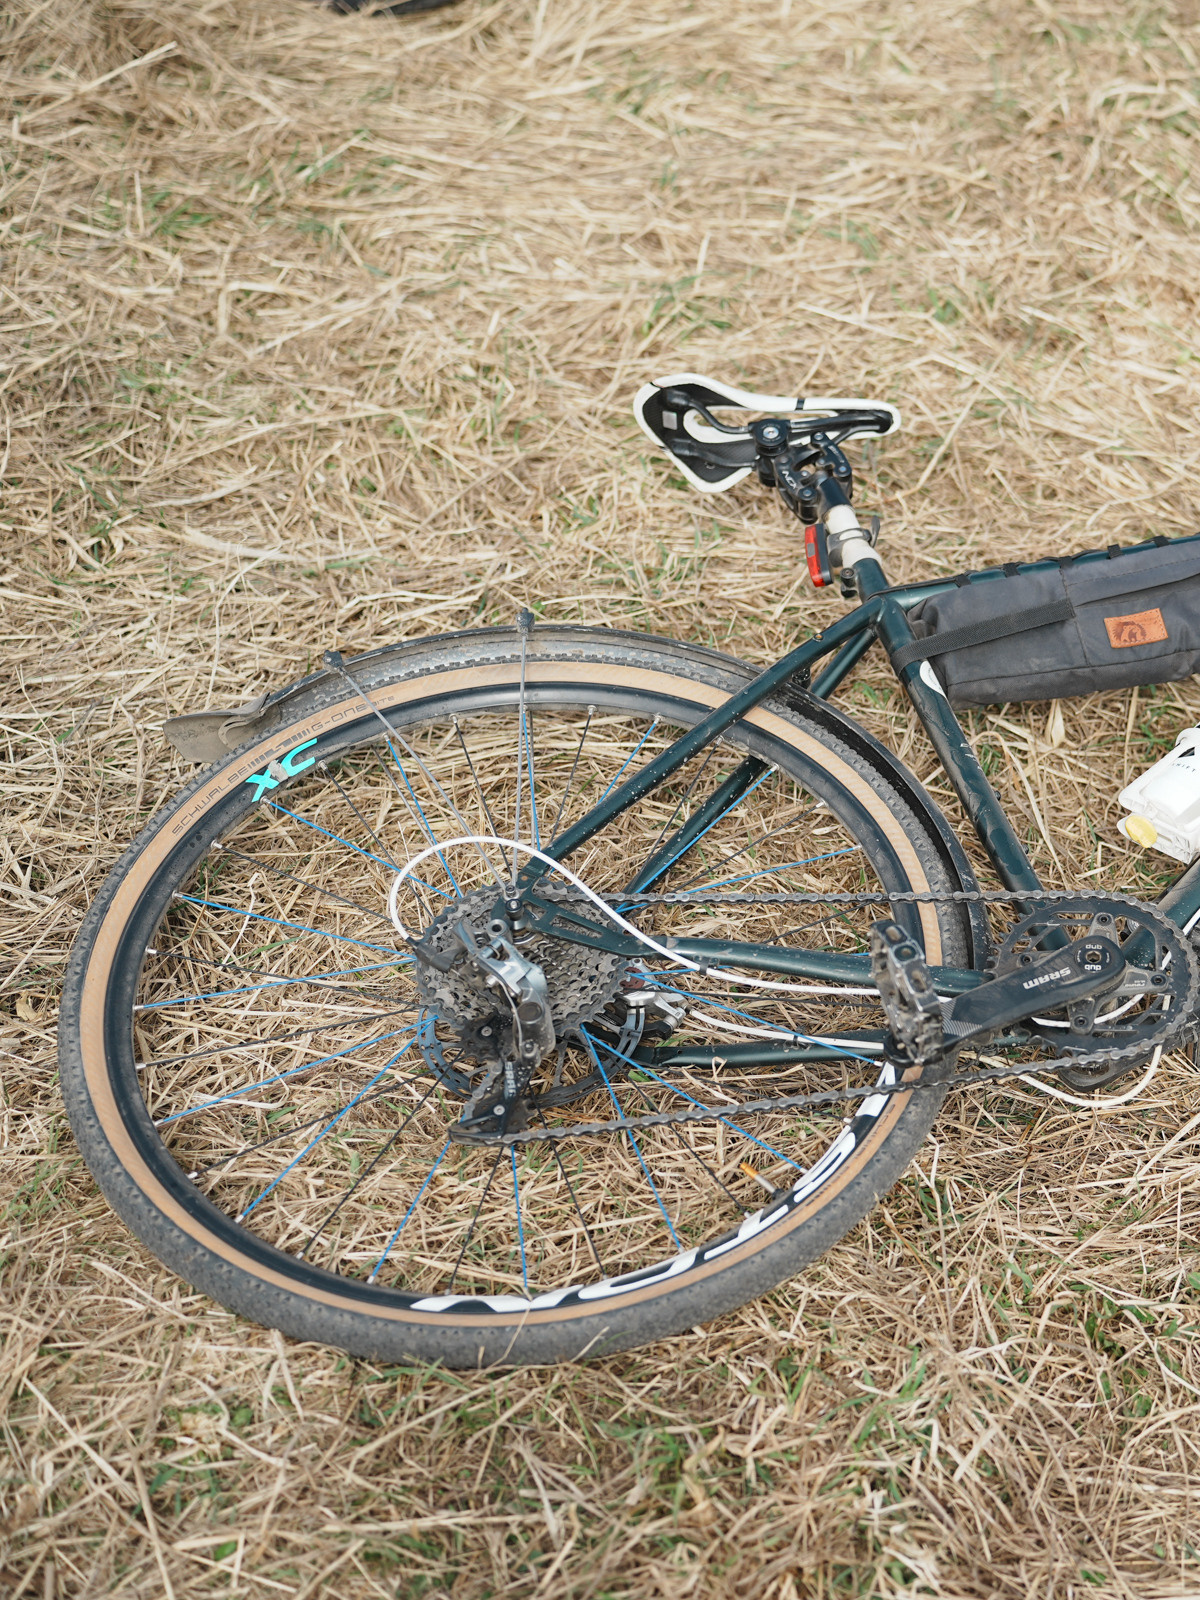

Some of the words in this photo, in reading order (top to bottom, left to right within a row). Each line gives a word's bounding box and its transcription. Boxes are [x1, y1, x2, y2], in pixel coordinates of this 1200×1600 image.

[171, 766, 250, 837] SCHWALBE
[311, 702, 368, 732] G-ONE
[245, 738, 318, 803] XC
[1022, 966, 1072, 990] SRAM
[411, 1061, 896, 1314] ASTON
